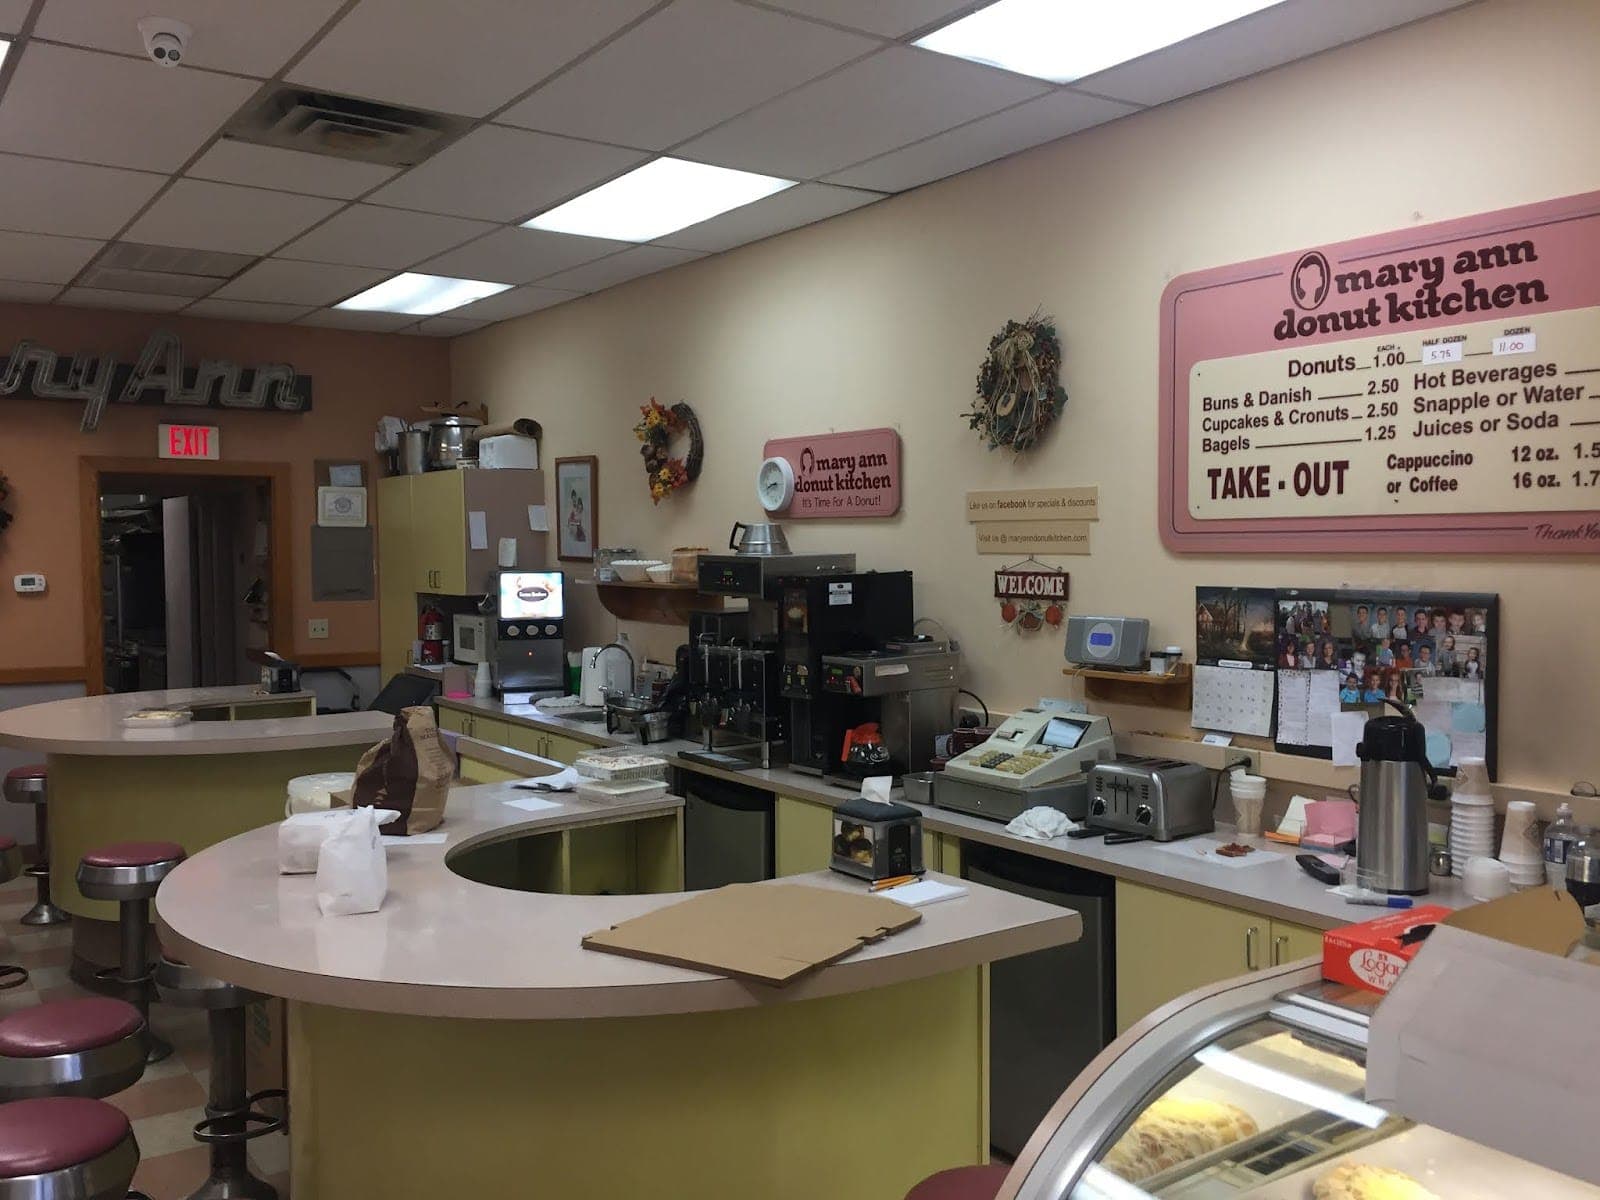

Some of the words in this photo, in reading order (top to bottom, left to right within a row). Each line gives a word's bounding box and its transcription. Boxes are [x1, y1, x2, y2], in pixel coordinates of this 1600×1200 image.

[1335, 256, 1445, 294] mary
[1454, 239, 1538, 275] ann
[1274, 298, 1381, 340] donut
[1388, 279, 1549, 322] kitchen
[1422, 338, 1440, 346] HALF
[1442, 335, 1468, 344] DOZEN
[1504, 327, 1531, 336] DOZEN
[1377, 344, 1396, 352] EACH
[119, 330, 306, 409] Ann
[1288, 354, 1356, 378] Donuts
[1373, 352, 1405, 369] 1.00
[1414, 372, 1446, 390] Hot
[1452, 363, 1557, 384] Beverages
[1203, 396, 1239, 412] Buns
[1243, 392, 1254, 408] &
[1259, 386, 1312, 406] Danish
[1367, 378, 1399, 395] 2.50
[1413, 392, 1490, 414] Snapple
[1496, 391, 1517, 406] or
[1523, 385, 1584, 404] Water
[1202, 414, 1269, 434] Cupcakes
[1274, 410, 1284, 426] &
[1289, 406, 1349, 425] Cronuts
[1367, 402, 1398, 418] 2.50
[1413, 420, 1473, 437] Juices
[1480, 418, 1501, 432] or
[1507, 411, 1559, 431] Soda
[169, 425, 210, 456] EXIT
[1202, 436, 1250, 455] Bagels
[1365, 425, 1396, 441] 1.25
[816, 455, 856, 473] mary
[859, 453, 888, 468] ann
[1387, 450, 1473, 472] Cappuccino
[1511, 446, 1531, 462] 12
[1535, 448, 1559, 461] oz.
[794, 475, 833, 492] donut
[835, 472, 891, 490] kitchen
[1207, 465, 1271, 500] TAKE
[1294, 460, 1349, 497] OUT
[1387, 480, 1401, 494] or
[1409, 476, 1458, 493] Coffee
[1513, 472, 1532, 488] 16
[1537, 474, 1561, 488] oz.
[814, 497, 831, 508] Time
[833, 496, 844, 507] For
[847, 496, 855, 506] A
[855, 495, 881, 506] Donut!
[997, 499, 1027, 509] facebook
[1028, 500, 1036, 508] for
[1037, 500, 1061, 509] specials
[1067, 498, 1096, 507] discounts
[997, 574, 1065, 596] WELCOME
